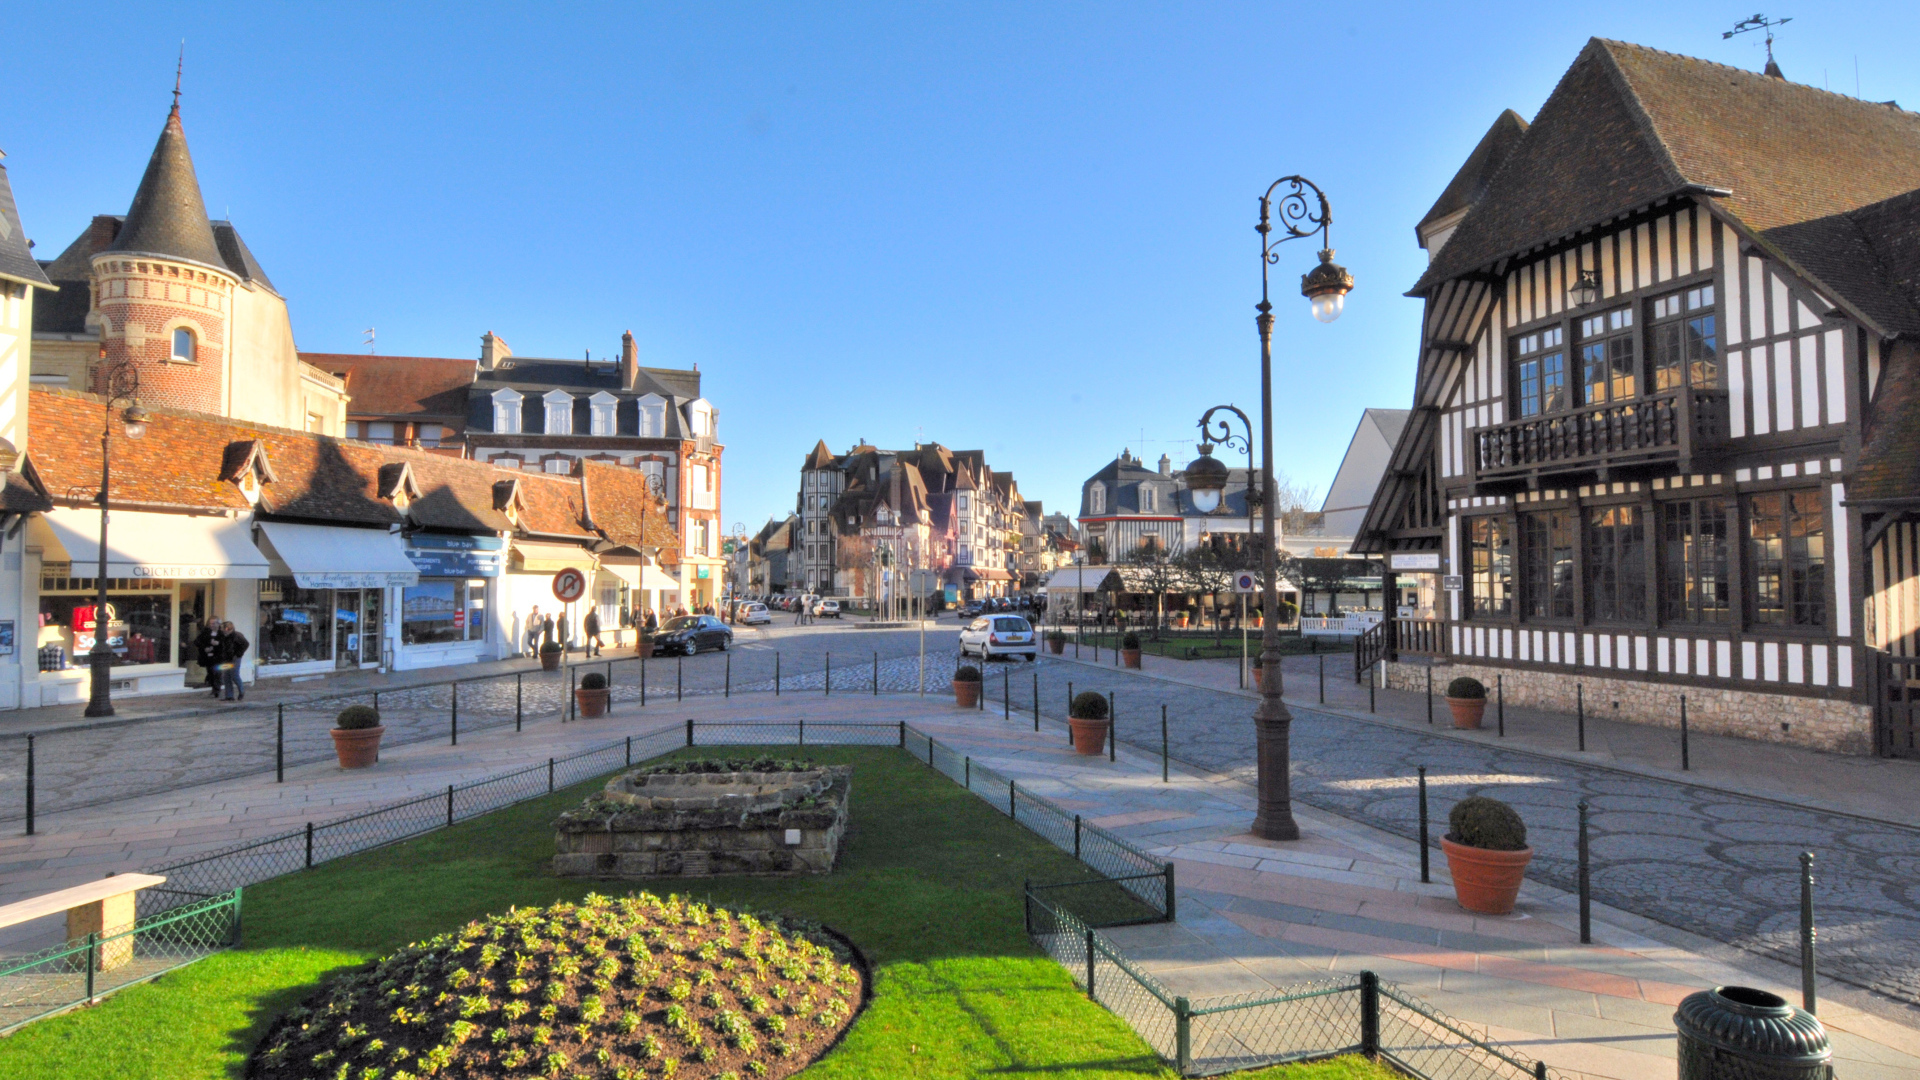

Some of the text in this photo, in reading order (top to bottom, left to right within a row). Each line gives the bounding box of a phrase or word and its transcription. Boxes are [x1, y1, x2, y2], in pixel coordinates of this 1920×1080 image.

[446, 540, 473, 548] blue bay
[132, 566, 217, 577] CRICKET & CO
[78, 634, 124, 648] Soes
